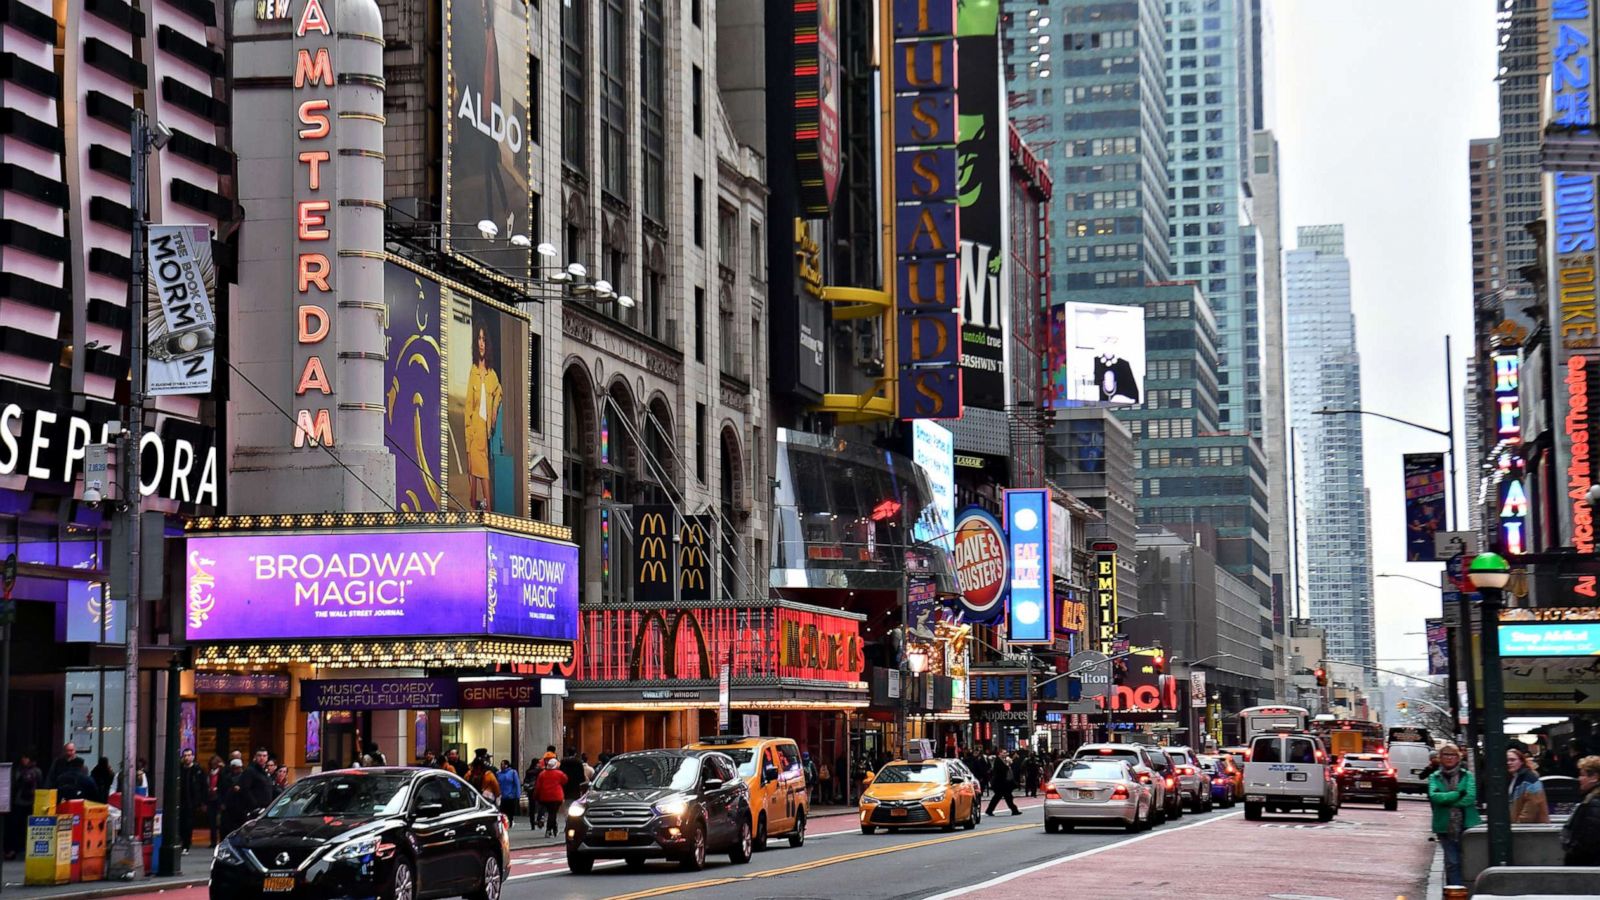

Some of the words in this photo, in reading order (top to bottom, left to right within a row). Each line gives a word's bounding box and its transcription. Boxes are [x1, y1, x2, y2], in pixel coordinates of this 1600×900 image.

[256, 0, 291, 20] NEW
[458, 84, 522, 154] ALDO
[294, 0, 335, 448] AMSTERDAM
[1555, 171, 1596, 254] UDIOS
[182, 261, 201, 300] BOOK
[1559, 266, 1598, 338] DUKE
[963, 332, 986, 345] untold
[956, 456, 982, 467] LAMAR
[249, 551, 445, 580] "BROADWAY
[955, 533, 990, 569] DAVE
[987, 533, 1000, 557] &
[958, 558, 1003, 595] BUSTER'S
[295, 579, 413, 606] MAGIC!"
[315, 610, 328, 618] THE
[329, 609, 348, 617] WALL
[349, 609, 373, 617] STREET
[374, 608, 405, 616] JOURNAL
[1097, 561, 1113, 655] EMPIRE
[381, 682, 434, 694] COMEDY
[1080, 673, 1109, 684] ilton
[674, 691, 700, 699] WINDOW
